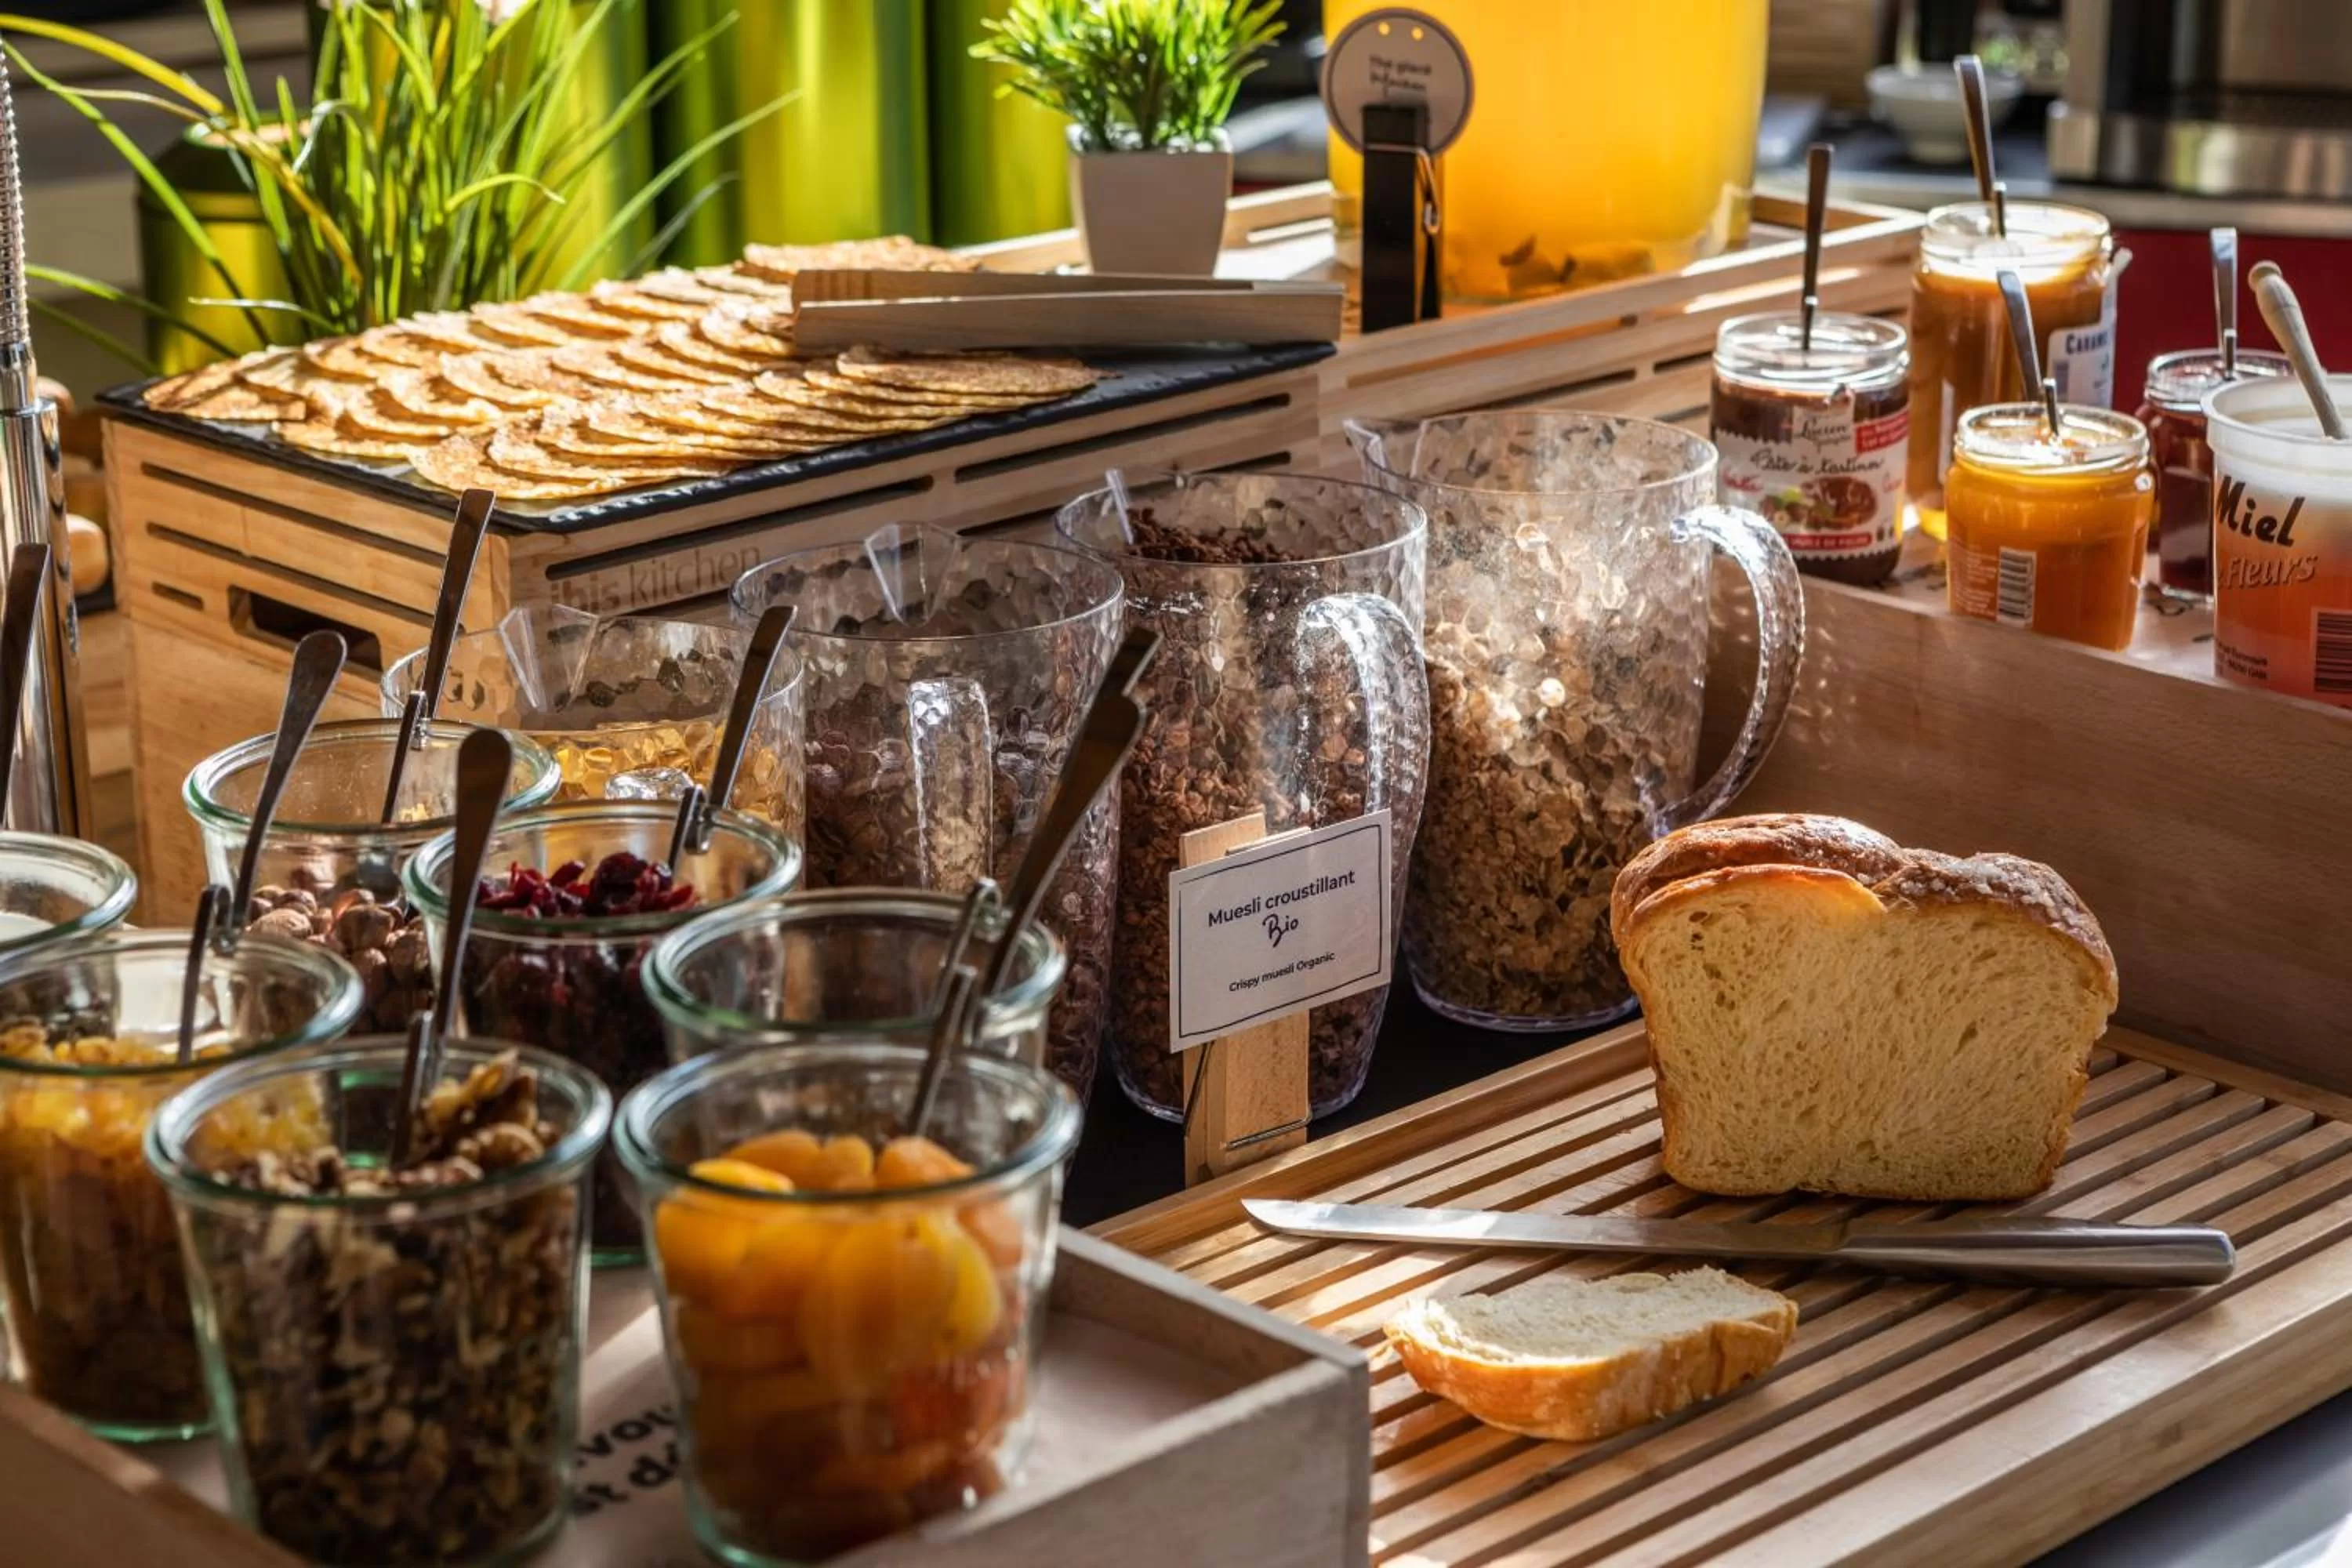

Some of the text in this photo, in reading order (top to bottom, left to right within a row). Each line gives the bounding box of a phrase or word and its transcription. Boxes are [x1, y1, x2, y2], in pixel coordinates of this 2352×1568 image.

[2215, 474, 2306, 547] Miel
[628, 547, 760, 608] kitchen
[1207, 869, 1356, 927] Muesli croustillant
[1262, 913, 1299, 948] Bio
[1229, 952, 1335, 992] Crispy muesli Organic
